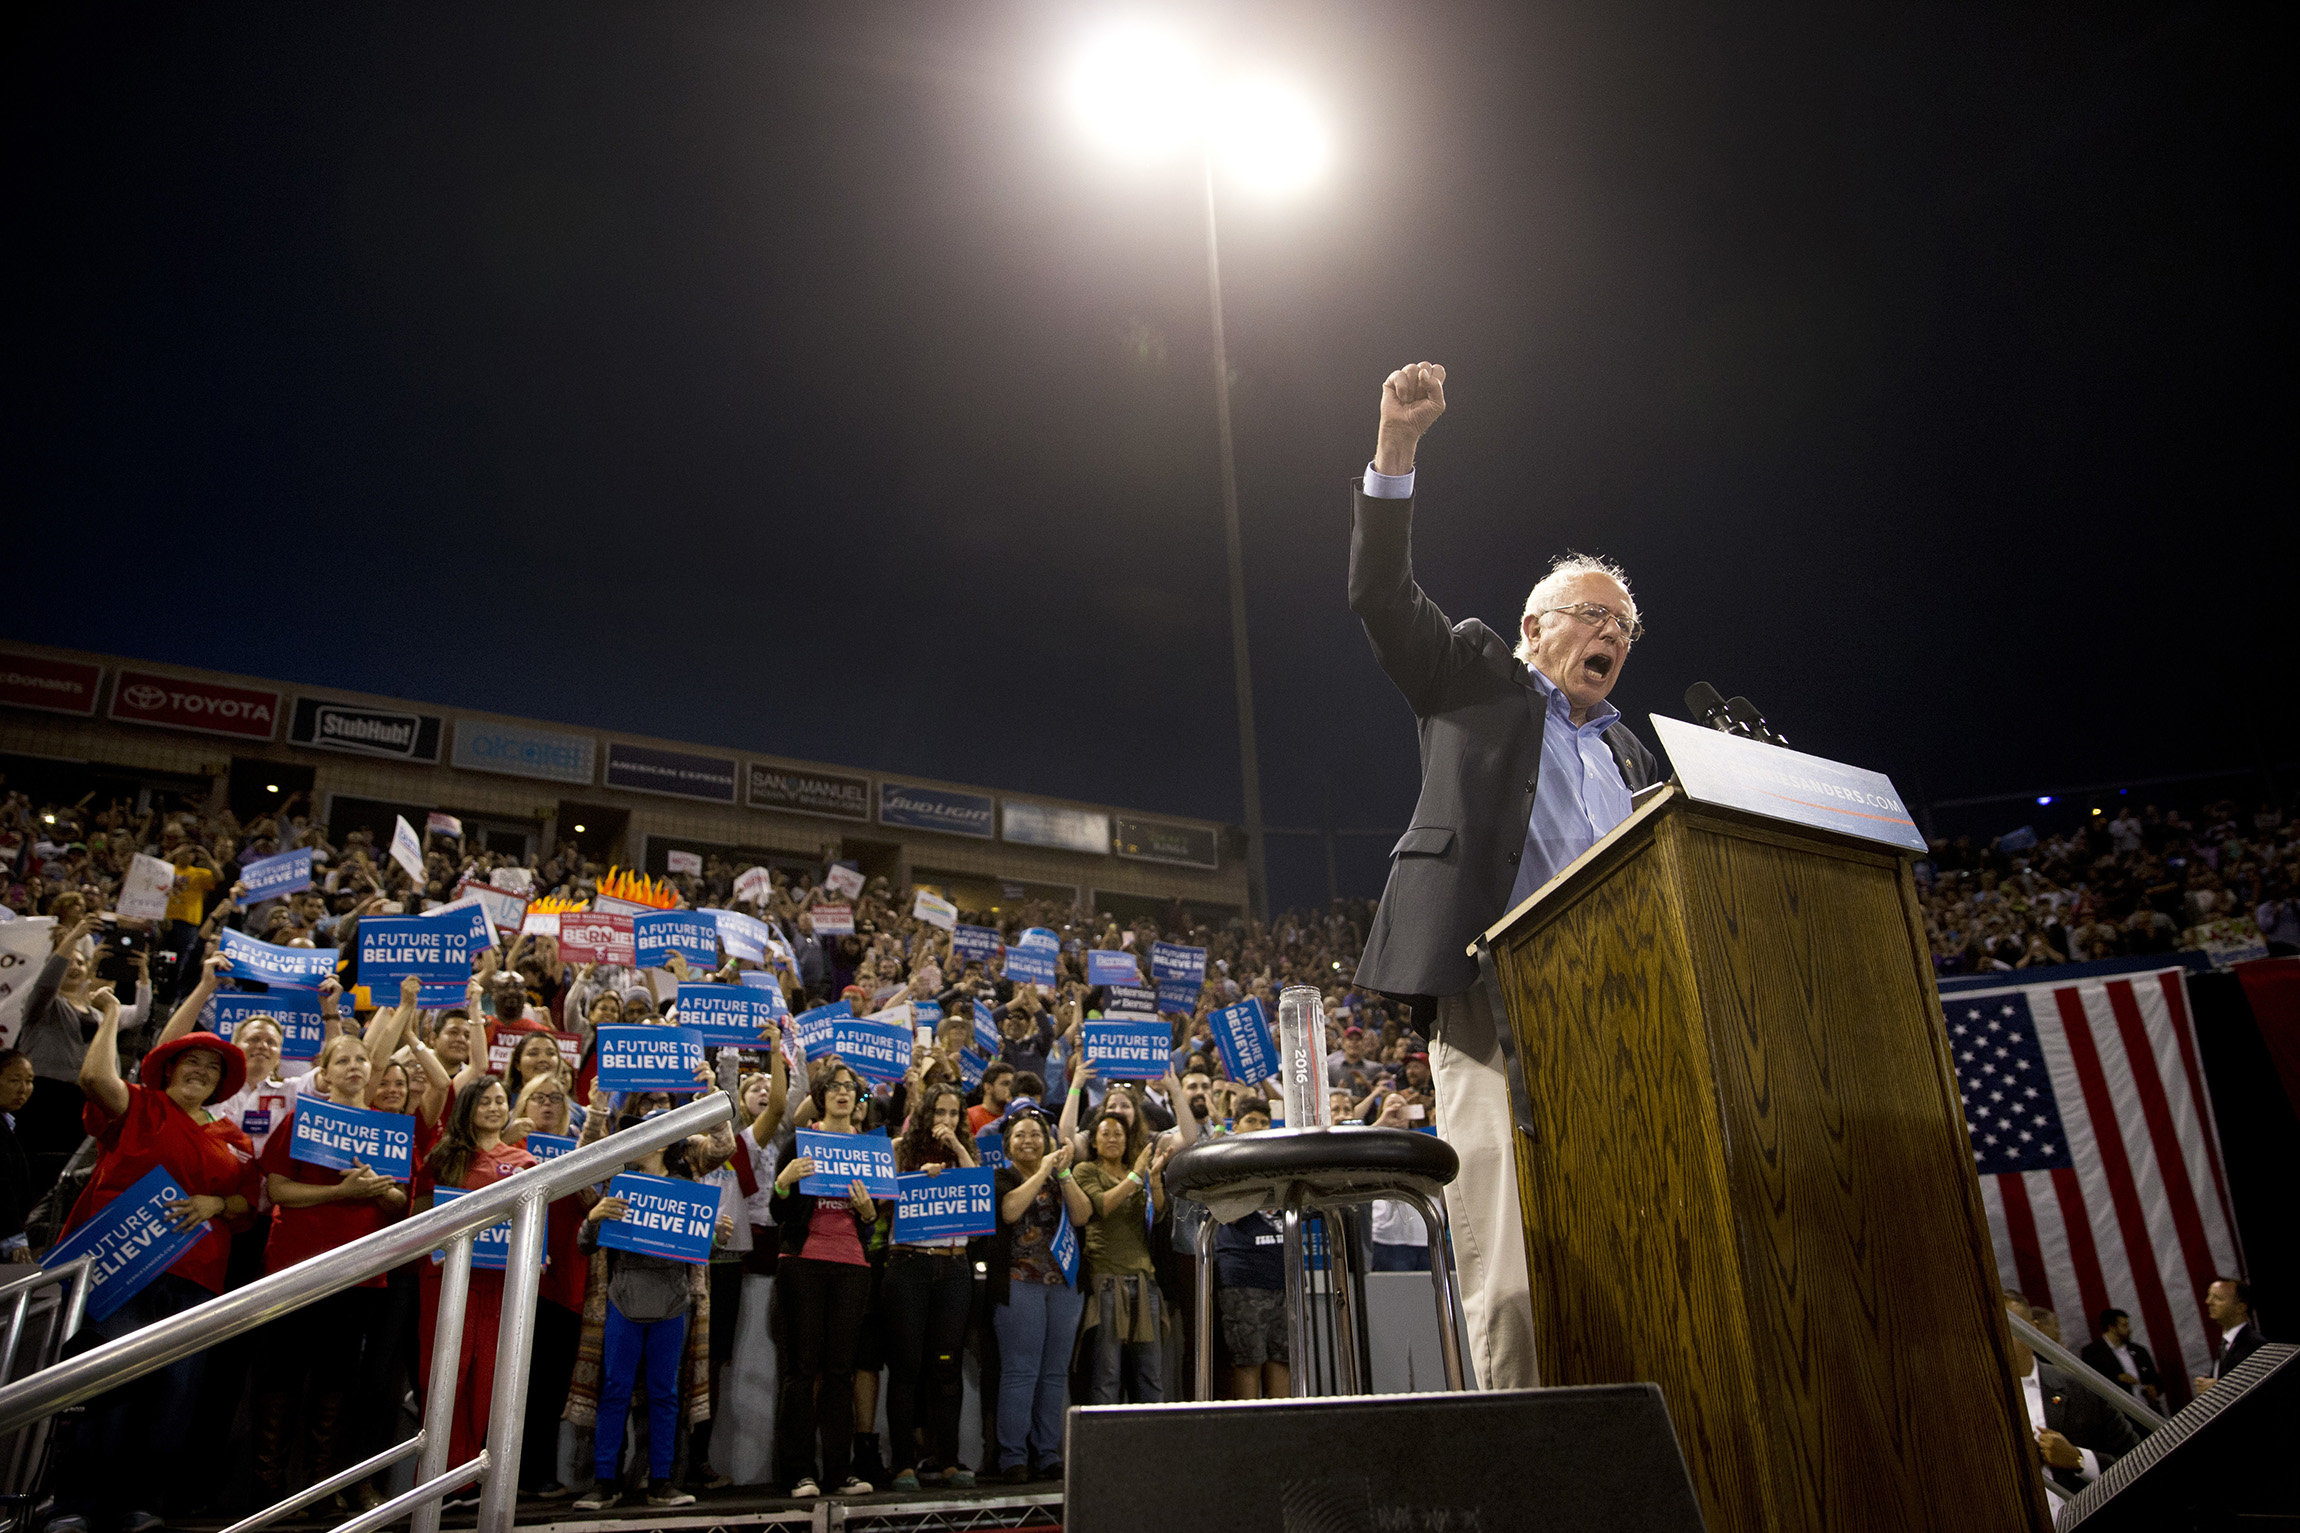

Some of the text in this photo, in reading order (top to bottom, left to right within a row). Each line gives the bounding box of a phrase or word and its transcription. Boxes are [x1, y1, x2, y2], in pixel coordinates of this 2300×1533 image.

[169, 692, 271, 722] TOYOTA
[323, 713, 412, 746] StubHub!
[610, 759, 678, 777] AMERICAN
[752, 771, 865, 801] SAN MANUEL
[1729, 764, 1902, 814] RNIESANDERS.COM
[294, 866, 310, 879] IN
[364, 933, 467, 947] A FUTURE TO
[469, 925, 485, 938] IN
[562, 924, 634, 945] BERNIE!
[638, 923, 715, 938] A FUTURE TO
[226, 939, 335, 966] A FUTURE TO
[638, 934, 698, 950] BELIEVE
[701, 939, 715, 952] IN
[224, 947, 333, 976] BELIEVE IN
[363, 948, 466, 964] BELIEVE IN
[1153, 955, 1204, 970] BELIEVE IN
[1111, 986, 1156, 999] Veterans
[680, 997, 770, 1015] A FUTURE TO
[221, 1007, 233, 1020] A
[300, 1012, 321, 1026] TO
[679, 1010, 749, 1028] BELIEVE
[800, 1016, 832, 1034] UTURE
[301, 1026, 320, 1041] IN
[836, 1030, 910, 1052] A FUTURE TO
[1088, 1033, 1169, 1048] A FUTURE TO
[1238, 1006, 1268, 1079] A FUTURE TO
[603, 1040, 701, 1056] A FUTURE TO
[836, 1041, 910, 1065] BELIEVE IN
[1088, 1046, 1169, 1061] BELIEVE IN
[1225, 1009, 1258, 1084] BELIEVE IN
[602, 1054, 701, 1070] BELIEVE IN
[1295, 1049, 1308, 1084] 2016
[299, 1111, 408, 1144] A FUTURE TO
[297, 1124, 408, 1160] BELIEVE IN
[533, 1144, 543, 1154] A
[803, 1145, 892, 1164] A FUTURE TO
[984, 1150, 1001, 1162] TO
[813, 1159, 894, 1179] ELIEVE IN
[899, 1183, 991, 1202] A FUTURE TO
[628, 1191, 687, 1215] FUTURE
[691, 1203, 713, 1220] TO
[898, 1198, 991, 1219] BELIEVE IN
[87, 1186, 178, 1259] UTURE TO
[617, 1208, 711, 1239] ELIEVE IN
[88, 1219, 168, 1293] ELIEVE
